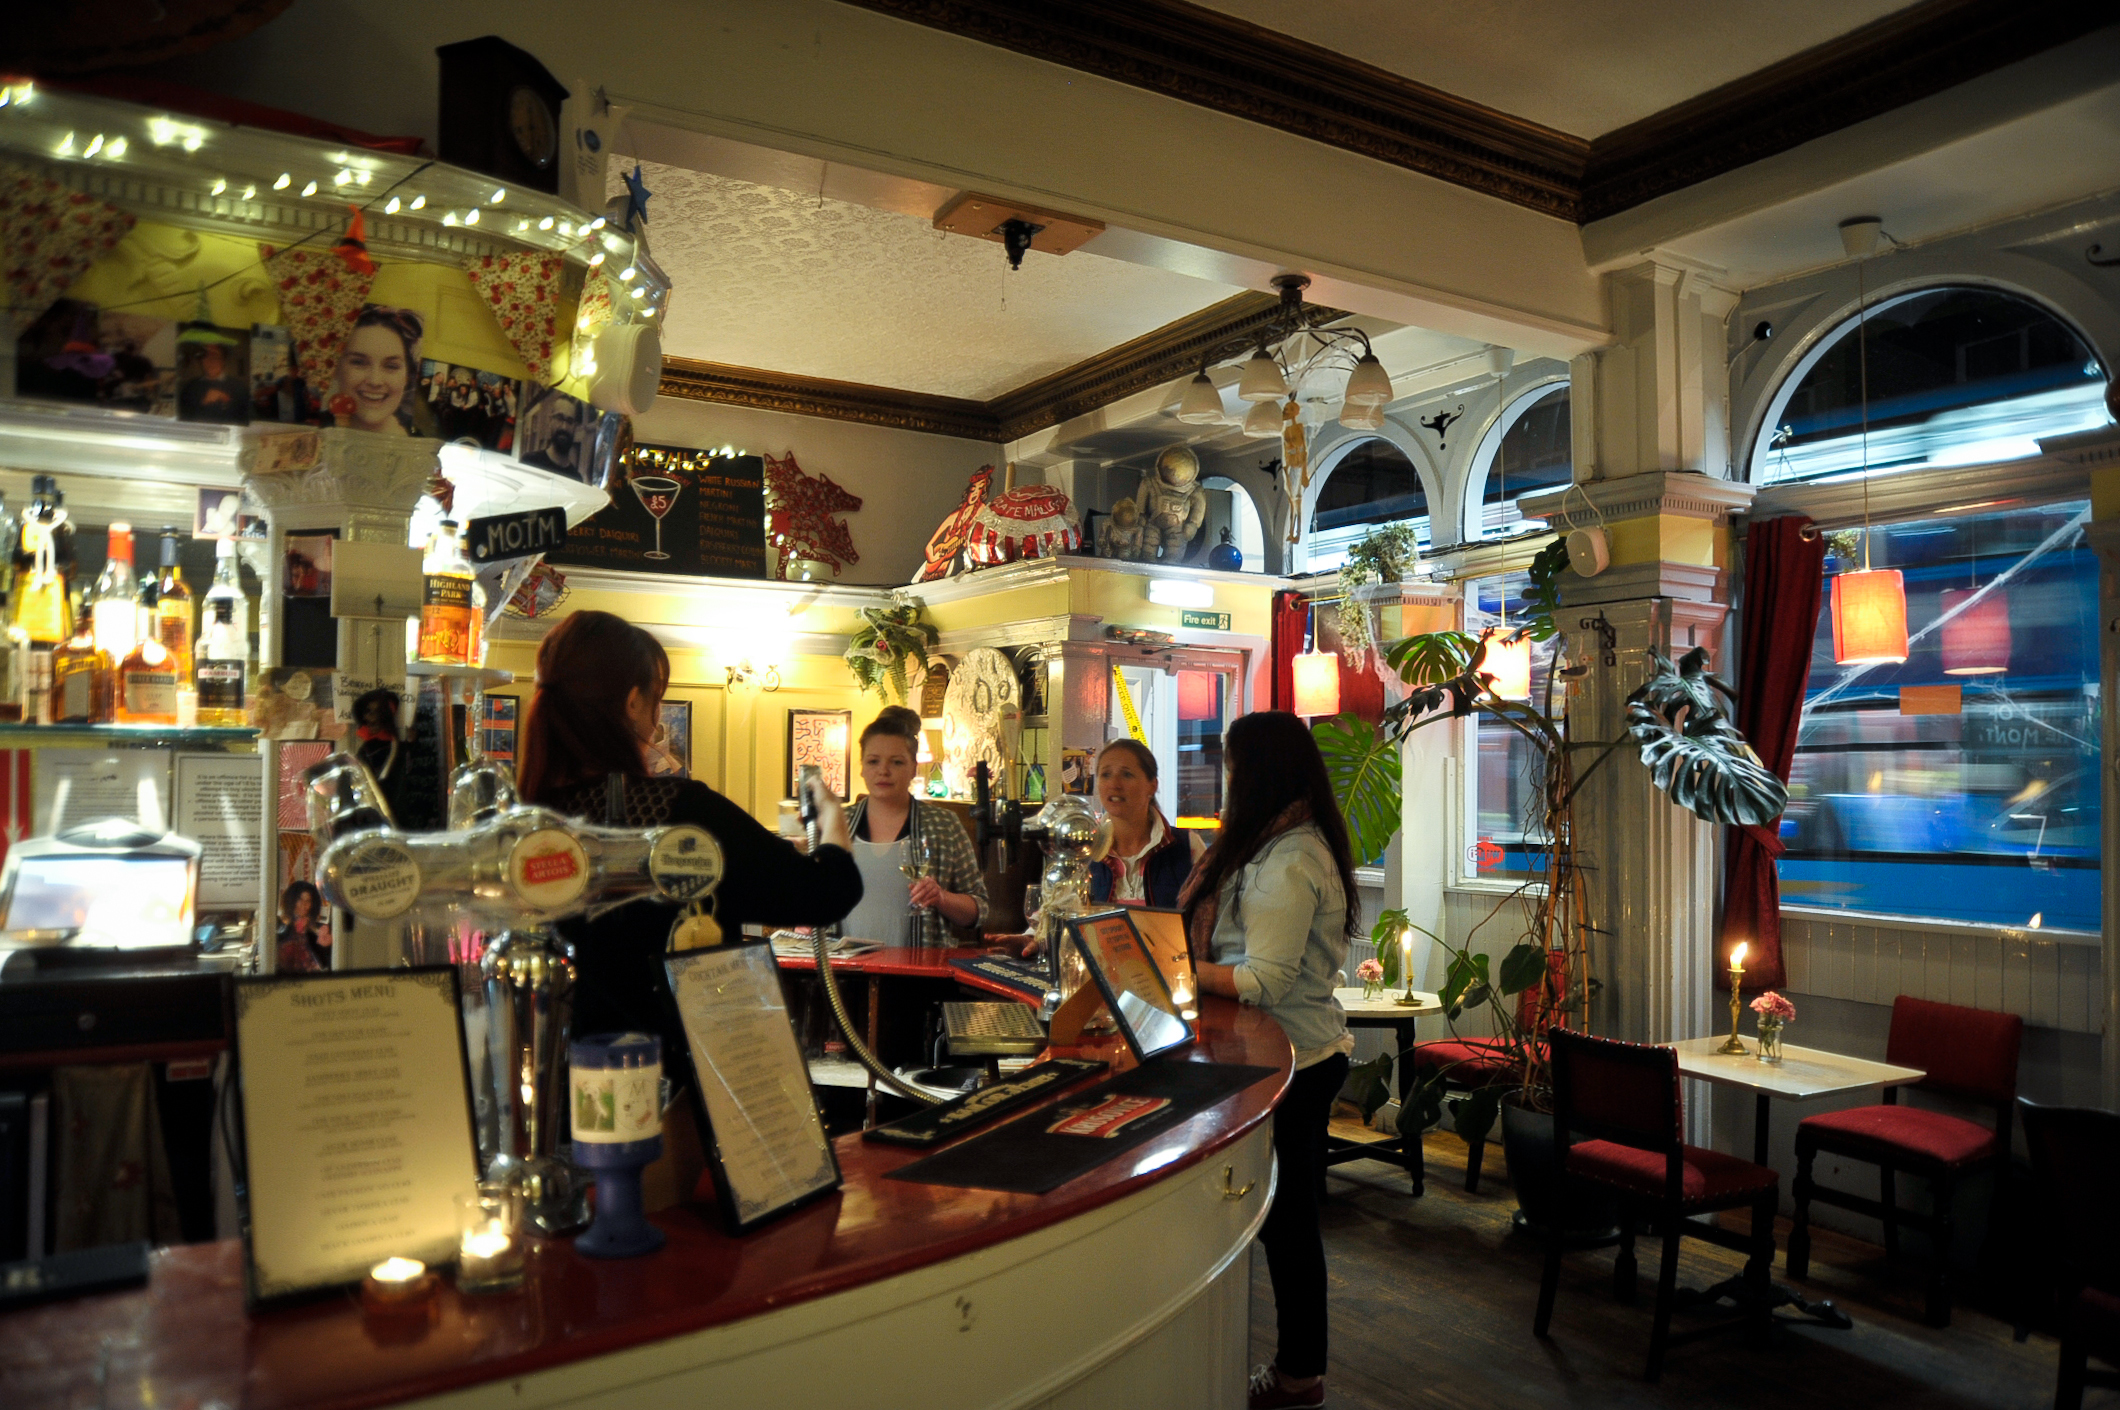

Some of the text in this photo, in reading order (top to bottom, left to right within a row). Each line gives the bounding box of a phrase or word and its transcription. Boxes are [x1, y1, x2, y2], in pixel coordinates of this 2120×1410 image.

[725, 477, 761, 489] RUSSIAN
[650, 494, 667, 511] £5
[429, 579, 471, 592] HIGHLAND
[440, 589, 462, 599] PARK
[1184, 613, 1216, 626] Fire exit
[530, 857, 567, 869] STELLA
[532, 866, 569, 879] ARTOIS
[349, 874, 415, 898] DRAUGHT
[290, 984, 396, 1008] SHOTS MENU
